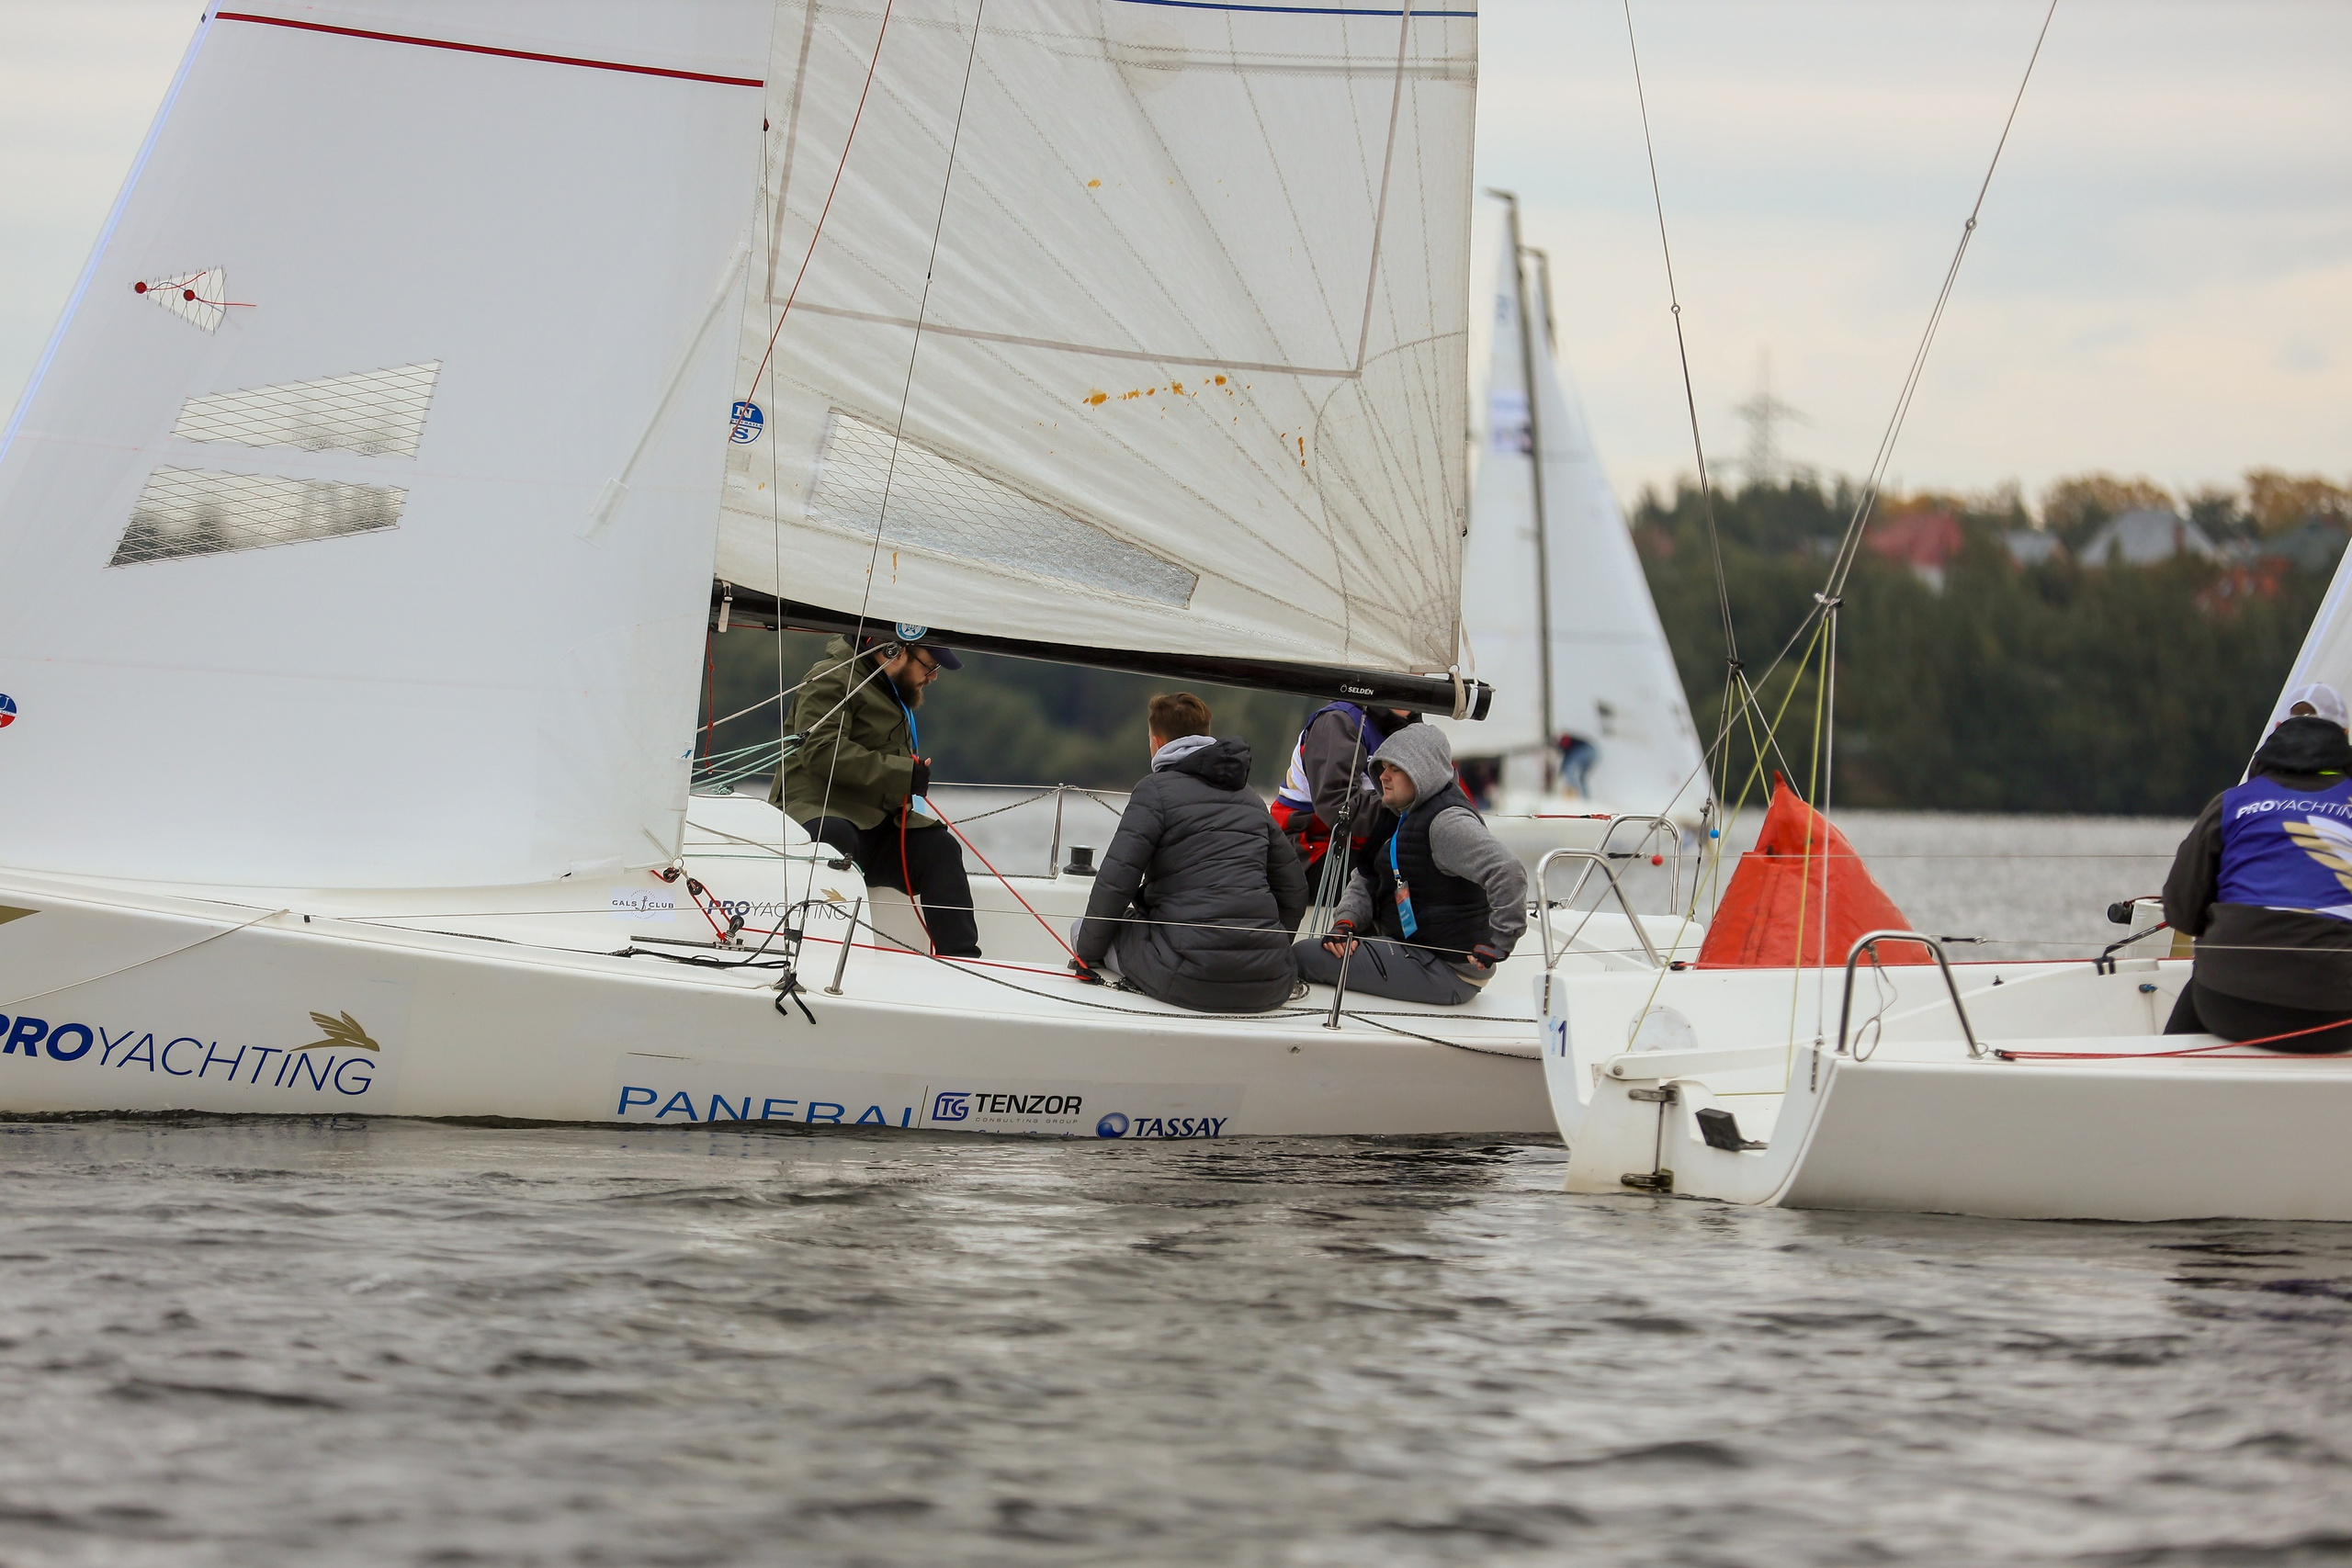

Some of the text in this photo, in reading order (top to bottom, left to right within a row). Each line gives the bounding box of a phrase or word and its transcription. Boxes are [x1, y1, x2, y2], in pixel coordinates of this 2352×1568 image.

[734, 405, 755, 419] N
[732, 427, 749, 439] S
[1557, 1020, 1567, 1057] 1
[0, 1013, 376, 1096] ROYACHTING
[975, 1093, 1082, 1114] TENZOR
[1134, 1118, 1228, 1137] TASSAY
